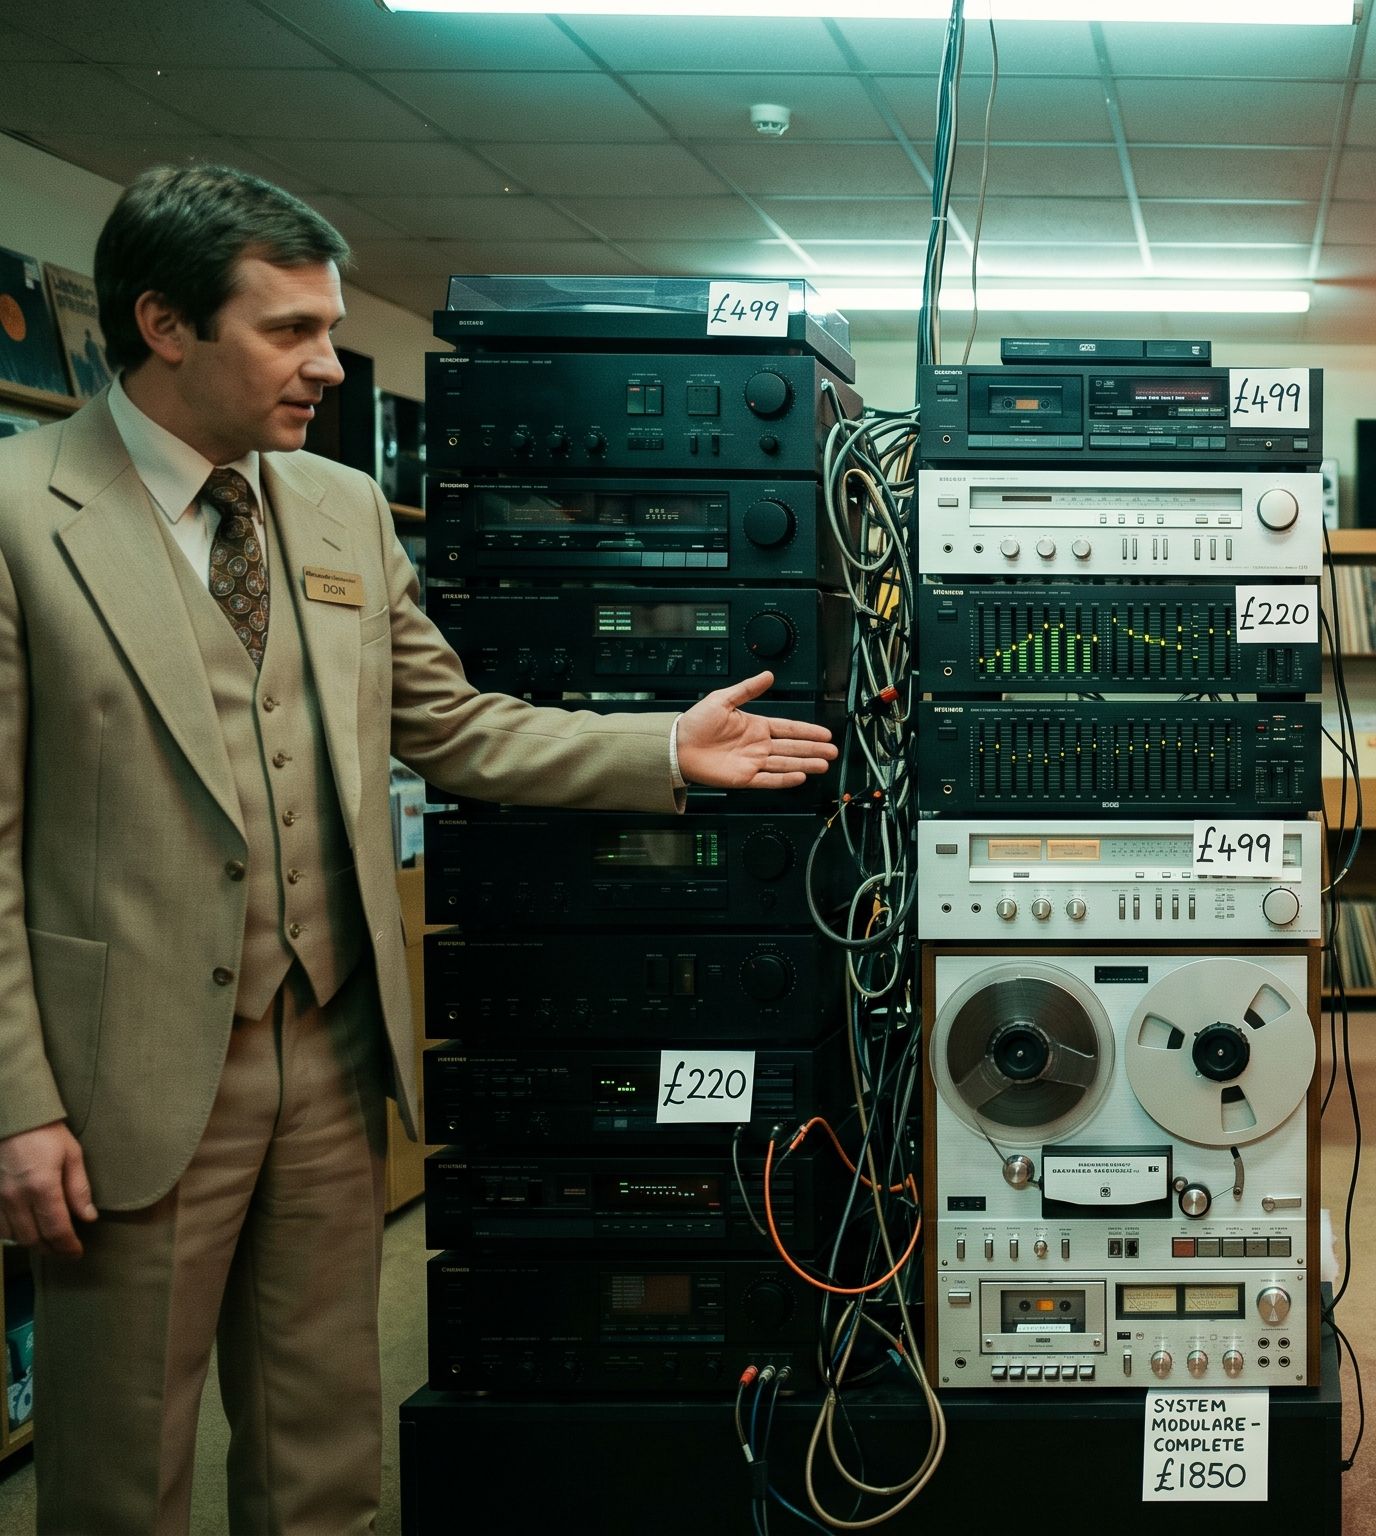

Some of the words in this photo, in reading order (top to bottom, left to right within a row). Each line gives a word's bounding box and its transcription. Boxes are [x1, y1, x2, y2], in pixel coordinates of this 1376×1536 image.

[711, 293, 779, 323] £499
[1233, 378, 1301, 414] £499
[323, 583, 346, 596] DON
[1239, 597, 1310, 631] £220
[1196, 826, 1271, 863] £499
[662, 1061, 747, 1107] £220
[1154, 1398, 1226, 1414] SYSTEM
[1151, 1416, 1247, 1432] MODULARE
[1153, 1437, 1245, 1453] COMPLETE
[1154, 1457, 1247, 1493] £1850
